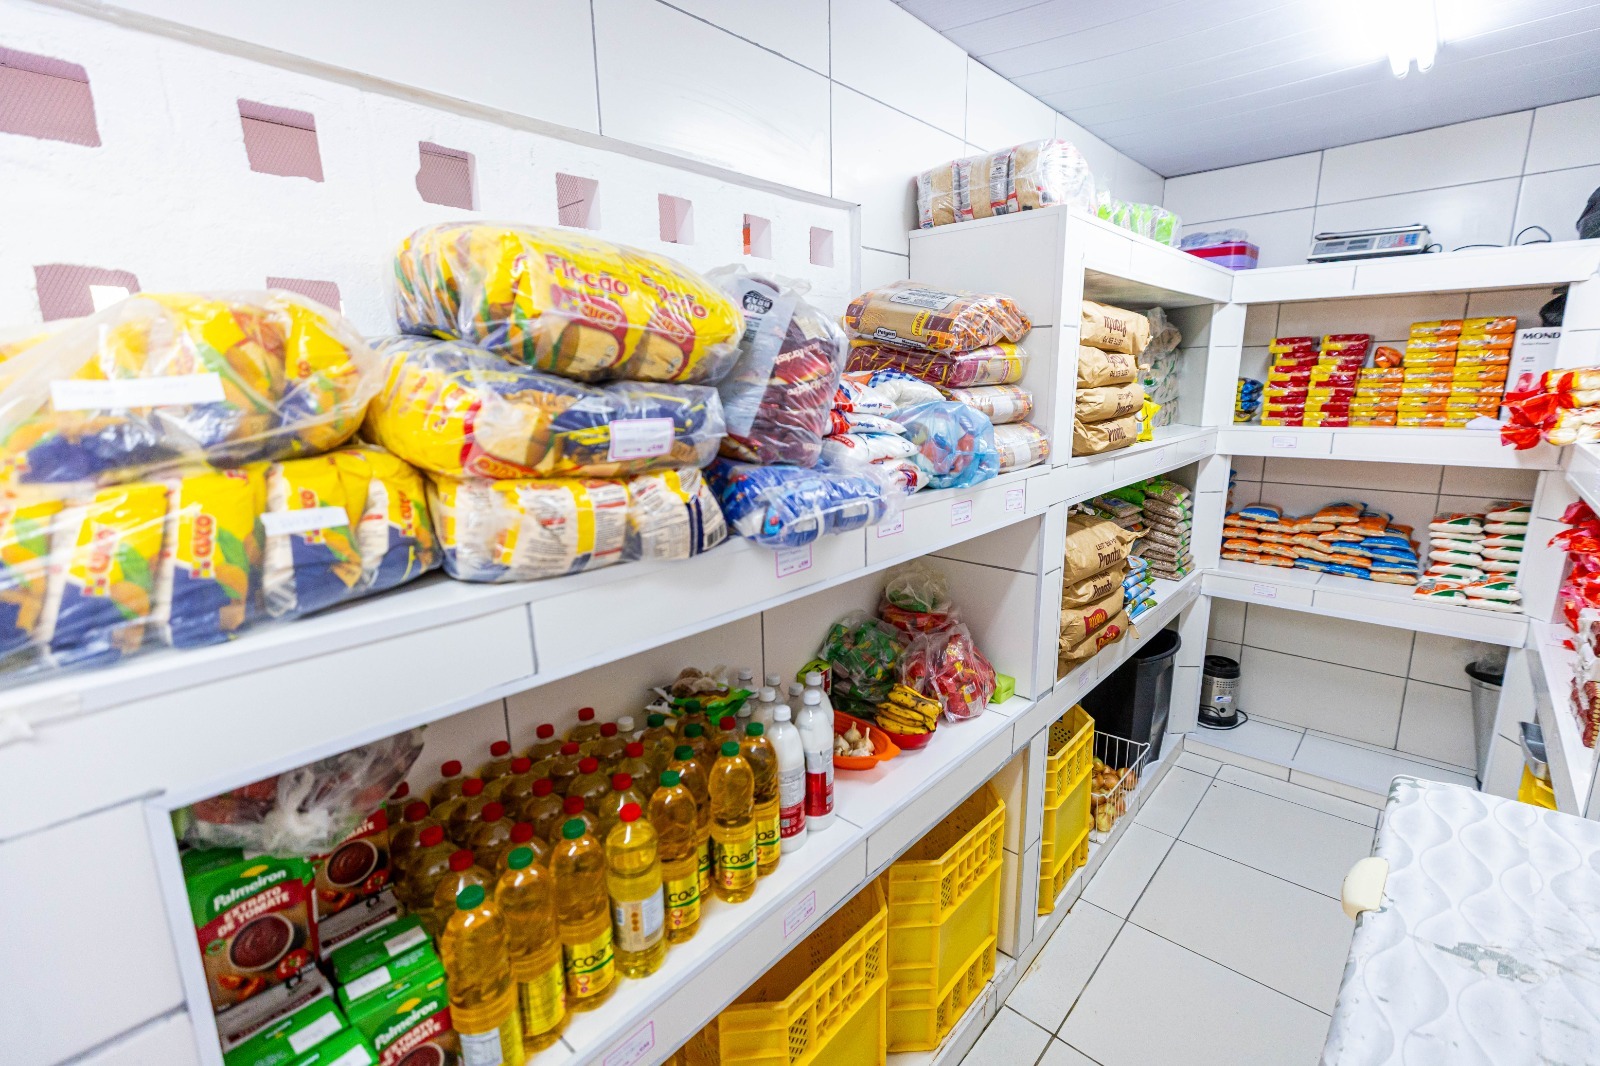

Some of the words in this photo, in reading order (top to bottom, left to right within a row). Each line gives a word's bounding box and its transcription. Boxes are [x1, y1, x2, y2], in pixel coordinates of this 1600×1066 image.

[213, 869, 287, 912] Palmeiron
[224, 886, 281, 921] EXTRATO
[217, 921, 235, 938] DE
[238, 891, 290, 923] TOMATE
[375, 1001, 438, 1050] Palmeiron
[384, 1018, 434, 1059] EXTRATO
[395, 1021, 441, 1057] TOMATE
